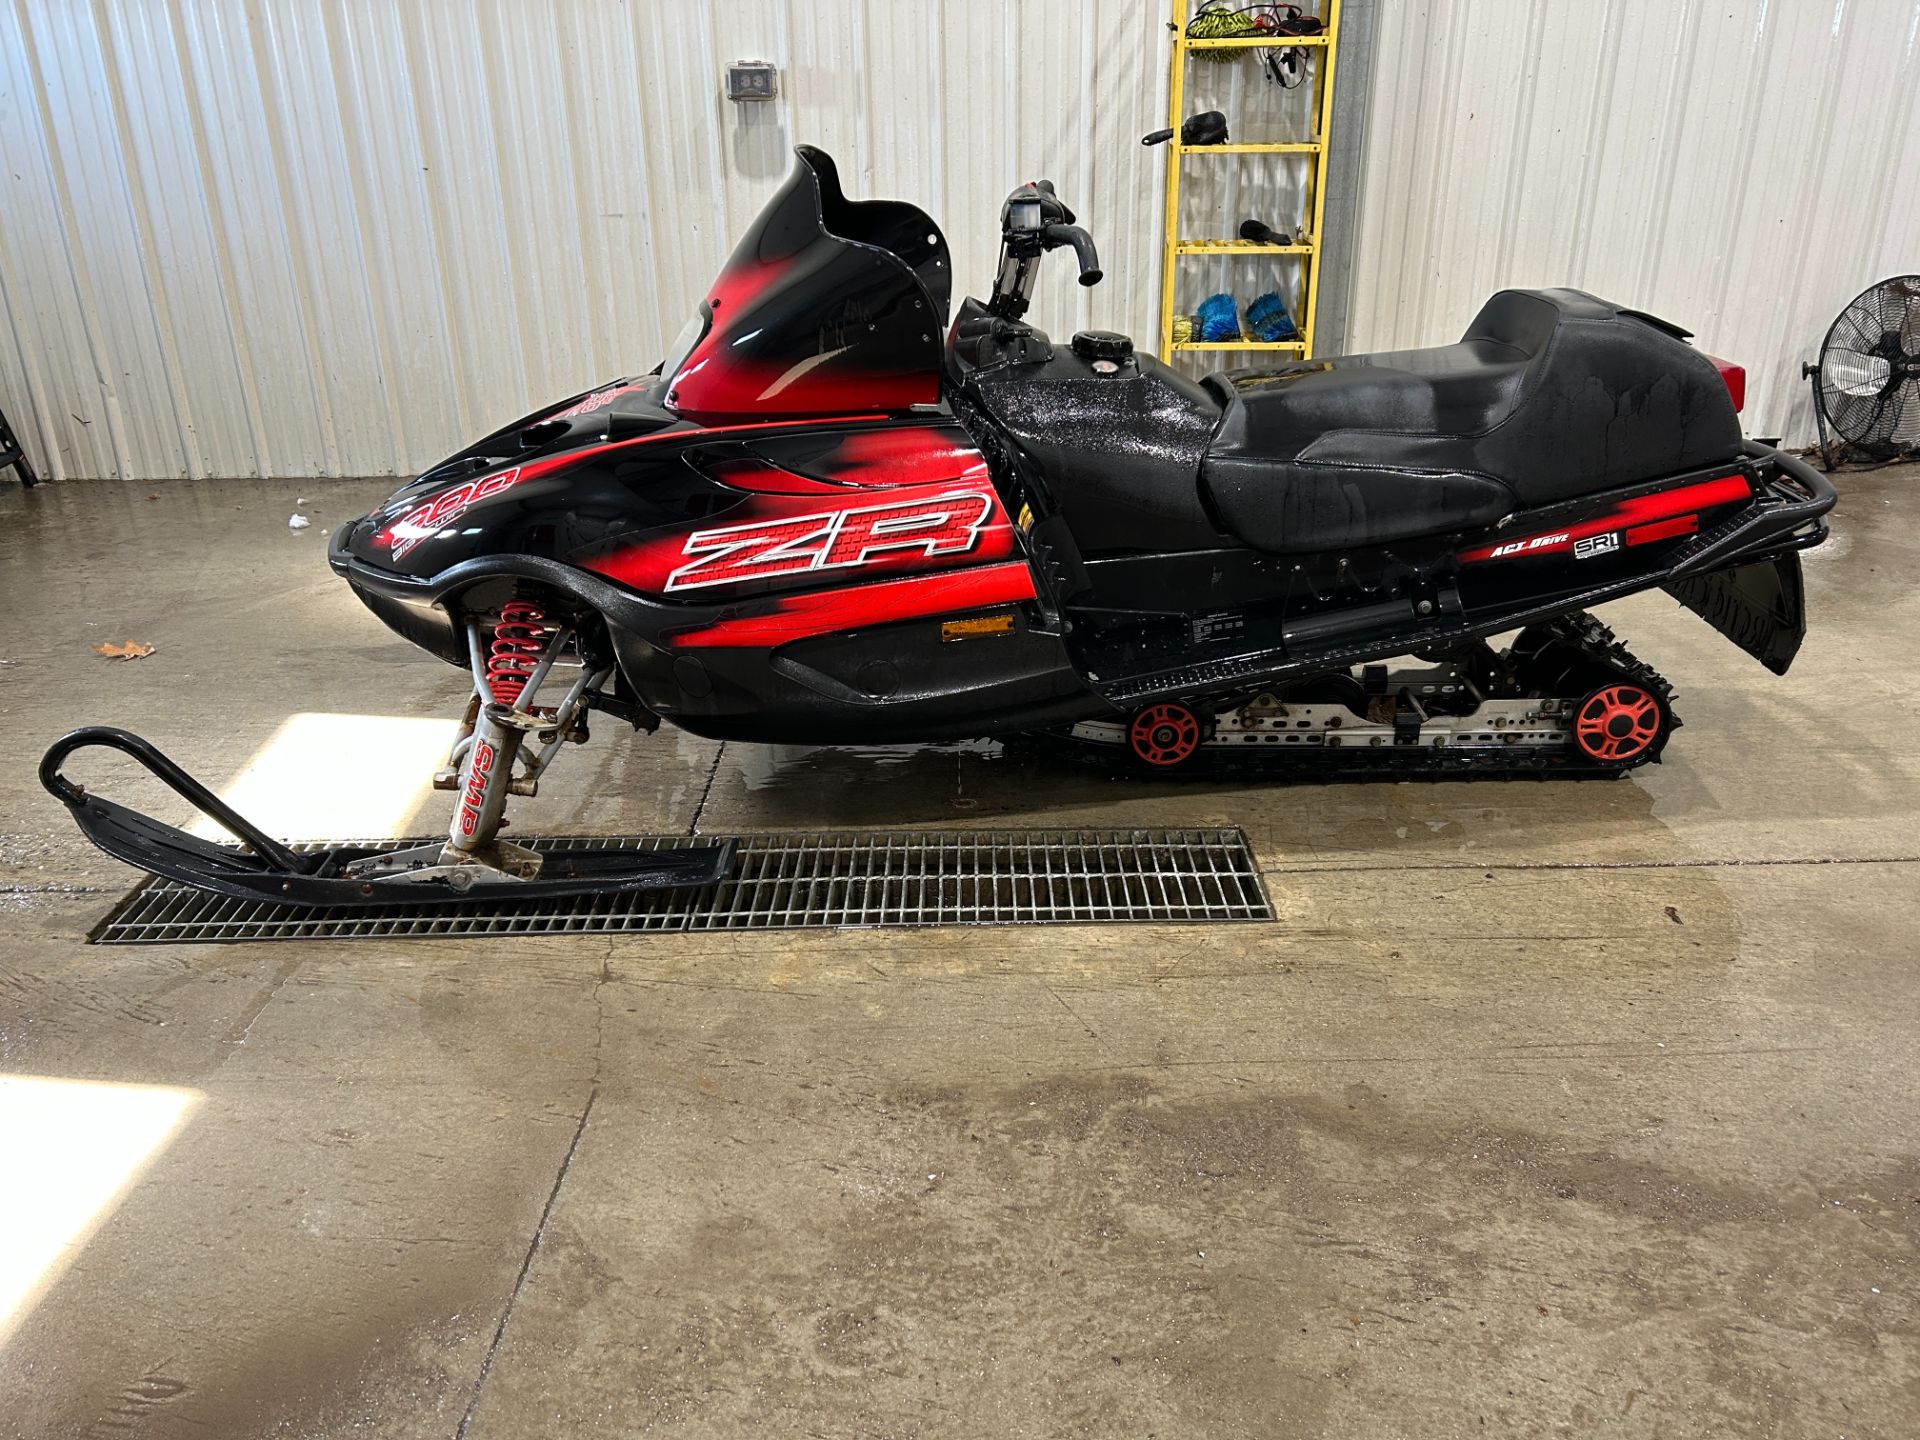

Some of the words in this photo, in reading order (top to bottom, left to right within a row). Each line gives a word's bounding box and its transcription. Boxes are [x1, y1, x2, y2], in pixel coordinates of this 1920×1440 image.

[664, 492, 992, 593] ZR
[1490, 541, 1527, 557] ACT
[460, 739, 494, 836] SMP
